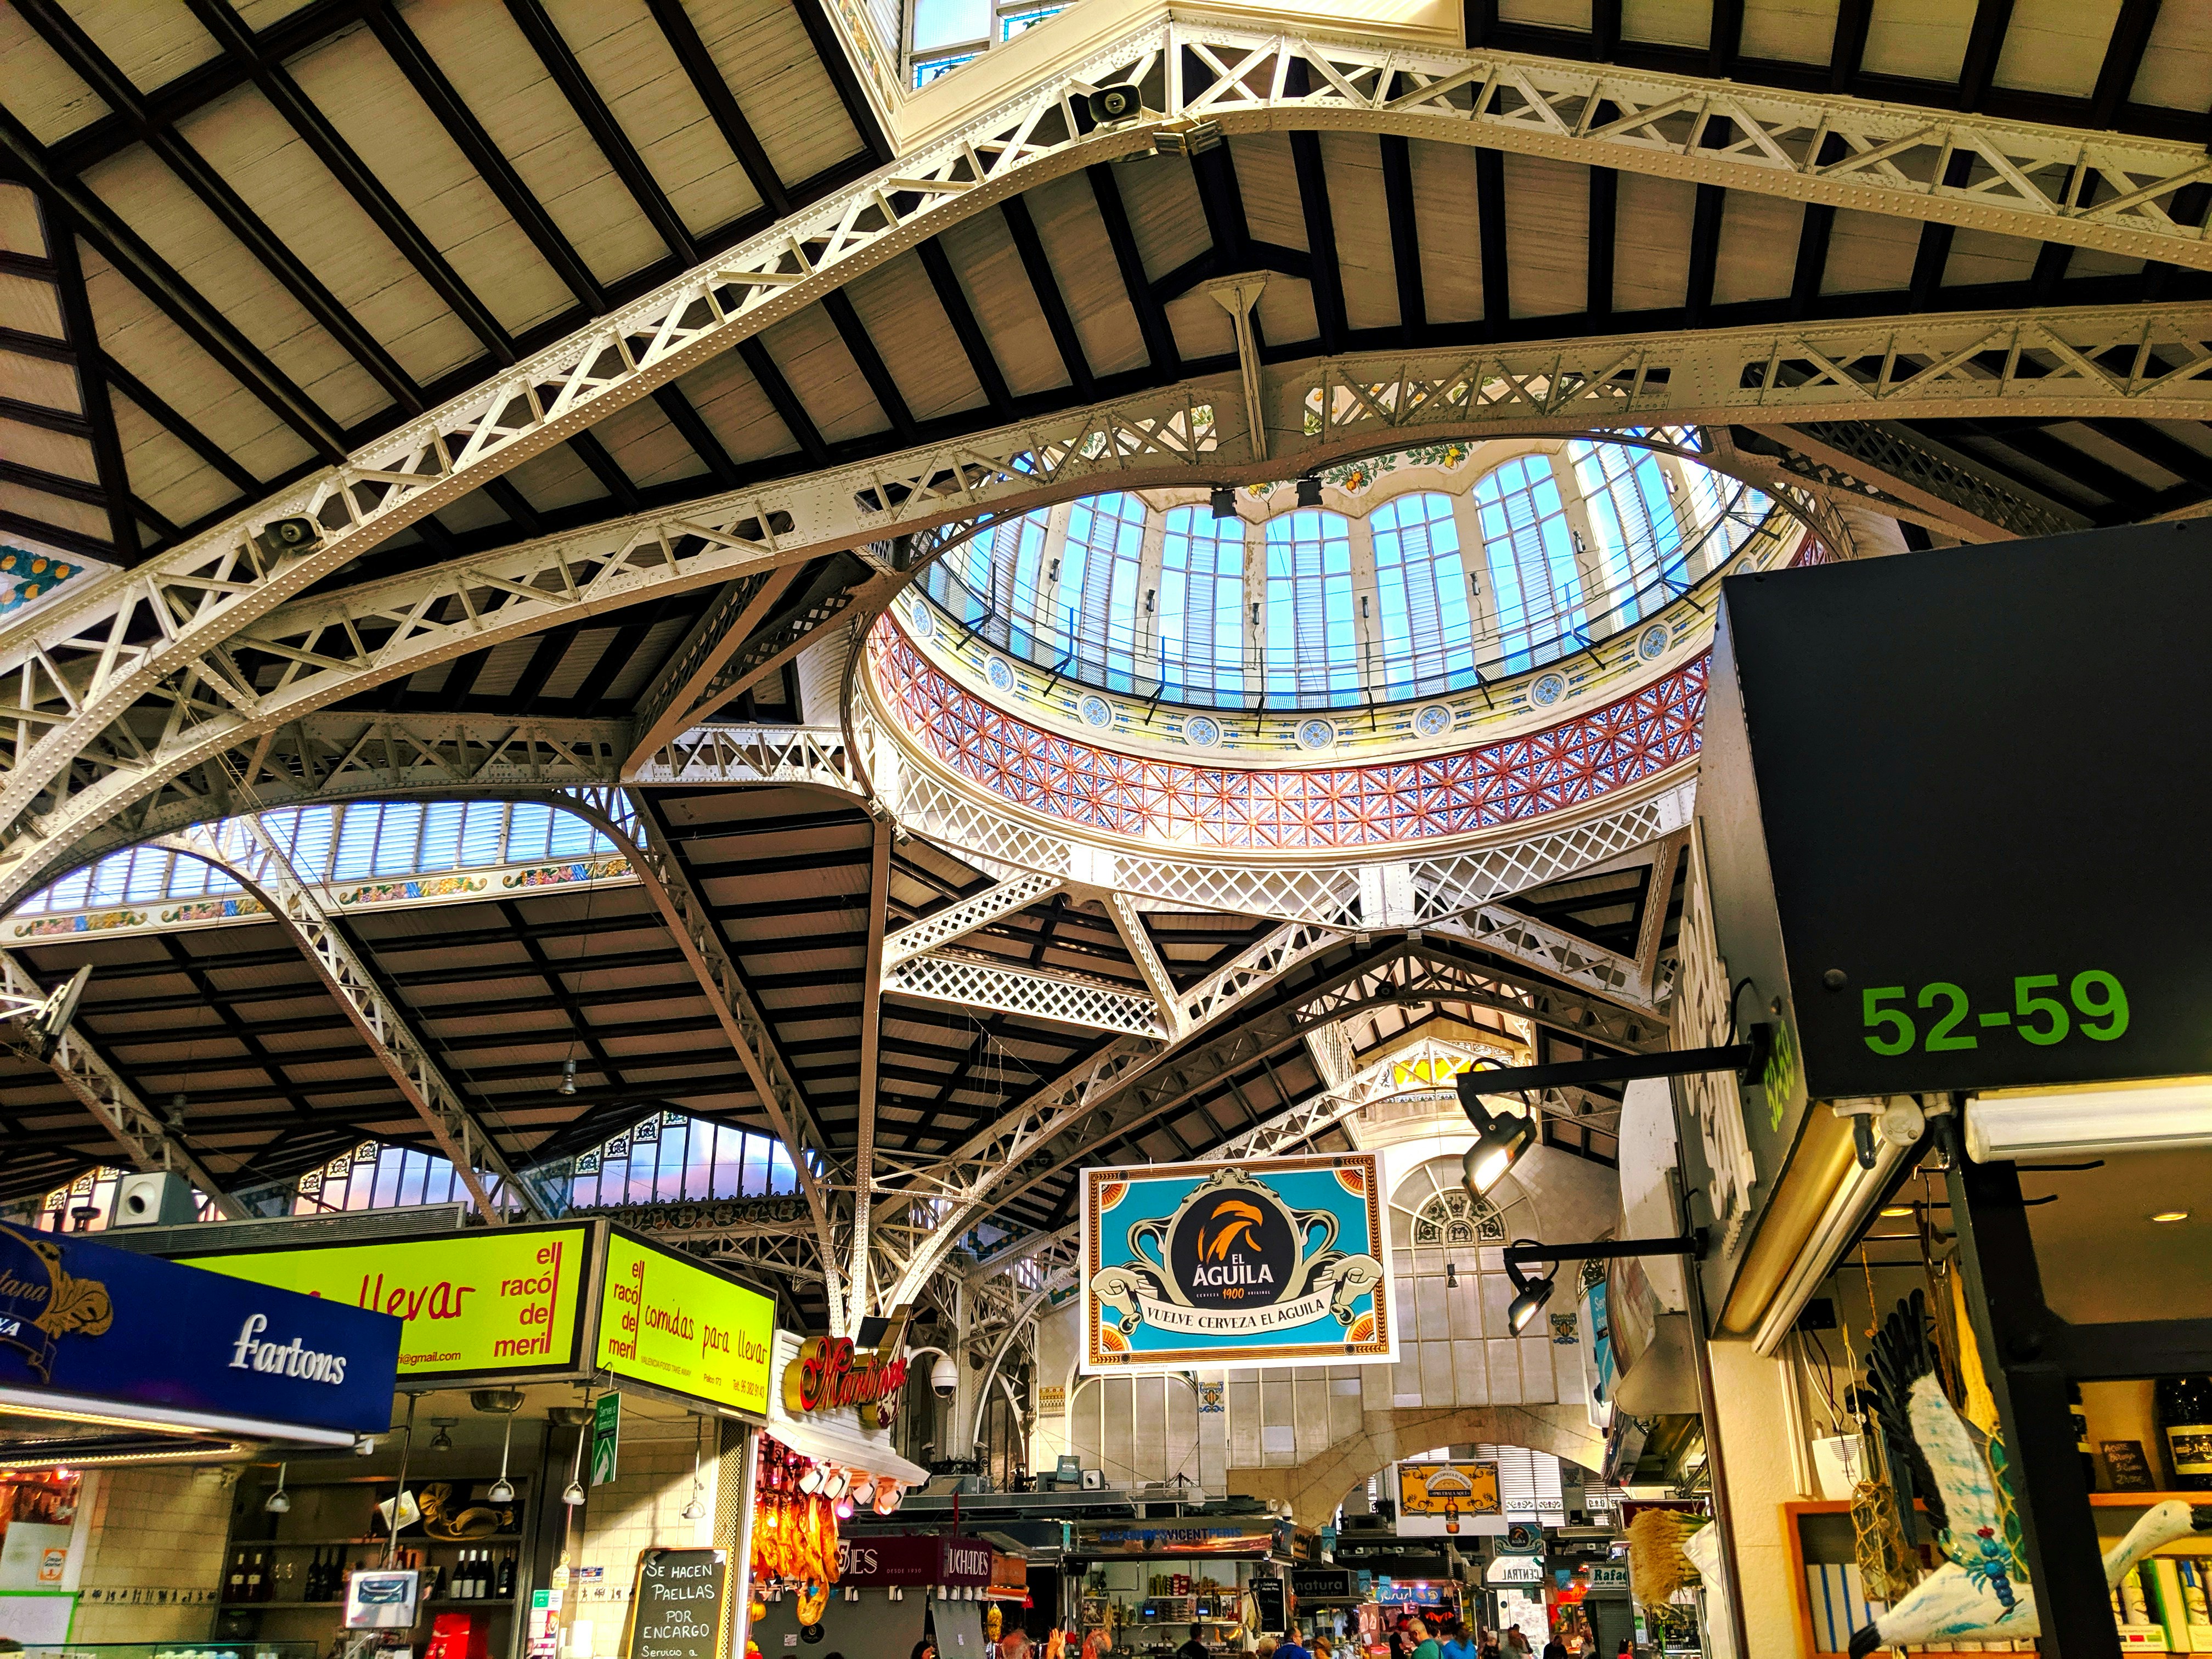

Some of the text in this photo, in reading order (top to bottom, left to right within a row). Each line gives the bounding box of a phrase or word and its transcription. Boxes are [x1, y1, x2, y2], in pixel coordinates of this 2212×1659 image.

[1863, 969, 2130, 1057] 52-59
[1753, 1019, 1795, 1133] 52-59
[537, 1242, 556, 1265] el
[1232, 1253, 1245, 1265] EL
[632, 1260, 642, 1280] el
[1192, 1263, 1274, 1287] ÁGUILA
[500, 1271, 552, 1297] racó
[613, 1283, 639, 1306] racó
[1222, 1288, 1244, 1300] 1900
[359, 1273, 476, 1321] llevar
[520, 1303, 549, 1326] de
[622, 1311, 636, 1333] de
[1147, 1299, 1325, 1329] VUELVE CERVEZA EL ÁGUILA
[645, 1305, 768, 1365] comidas para llevar
[229, 1313, 347, 1386] fartons
[1167, 1528, 1208, 1540] VICENT
[646, 1564, 712, 1578] SE HACEN
[949, 1548, 989, 1575] UCHADES
[651, 1584, 715, 1601] PAELLAS
[1295, 1580, 1343, 1591] natura
[665, 1610, 693, 1623] POR
[643, 1623, 710, 1639] ENCARGO
[641, 1645, 682, 1658] Servicio
